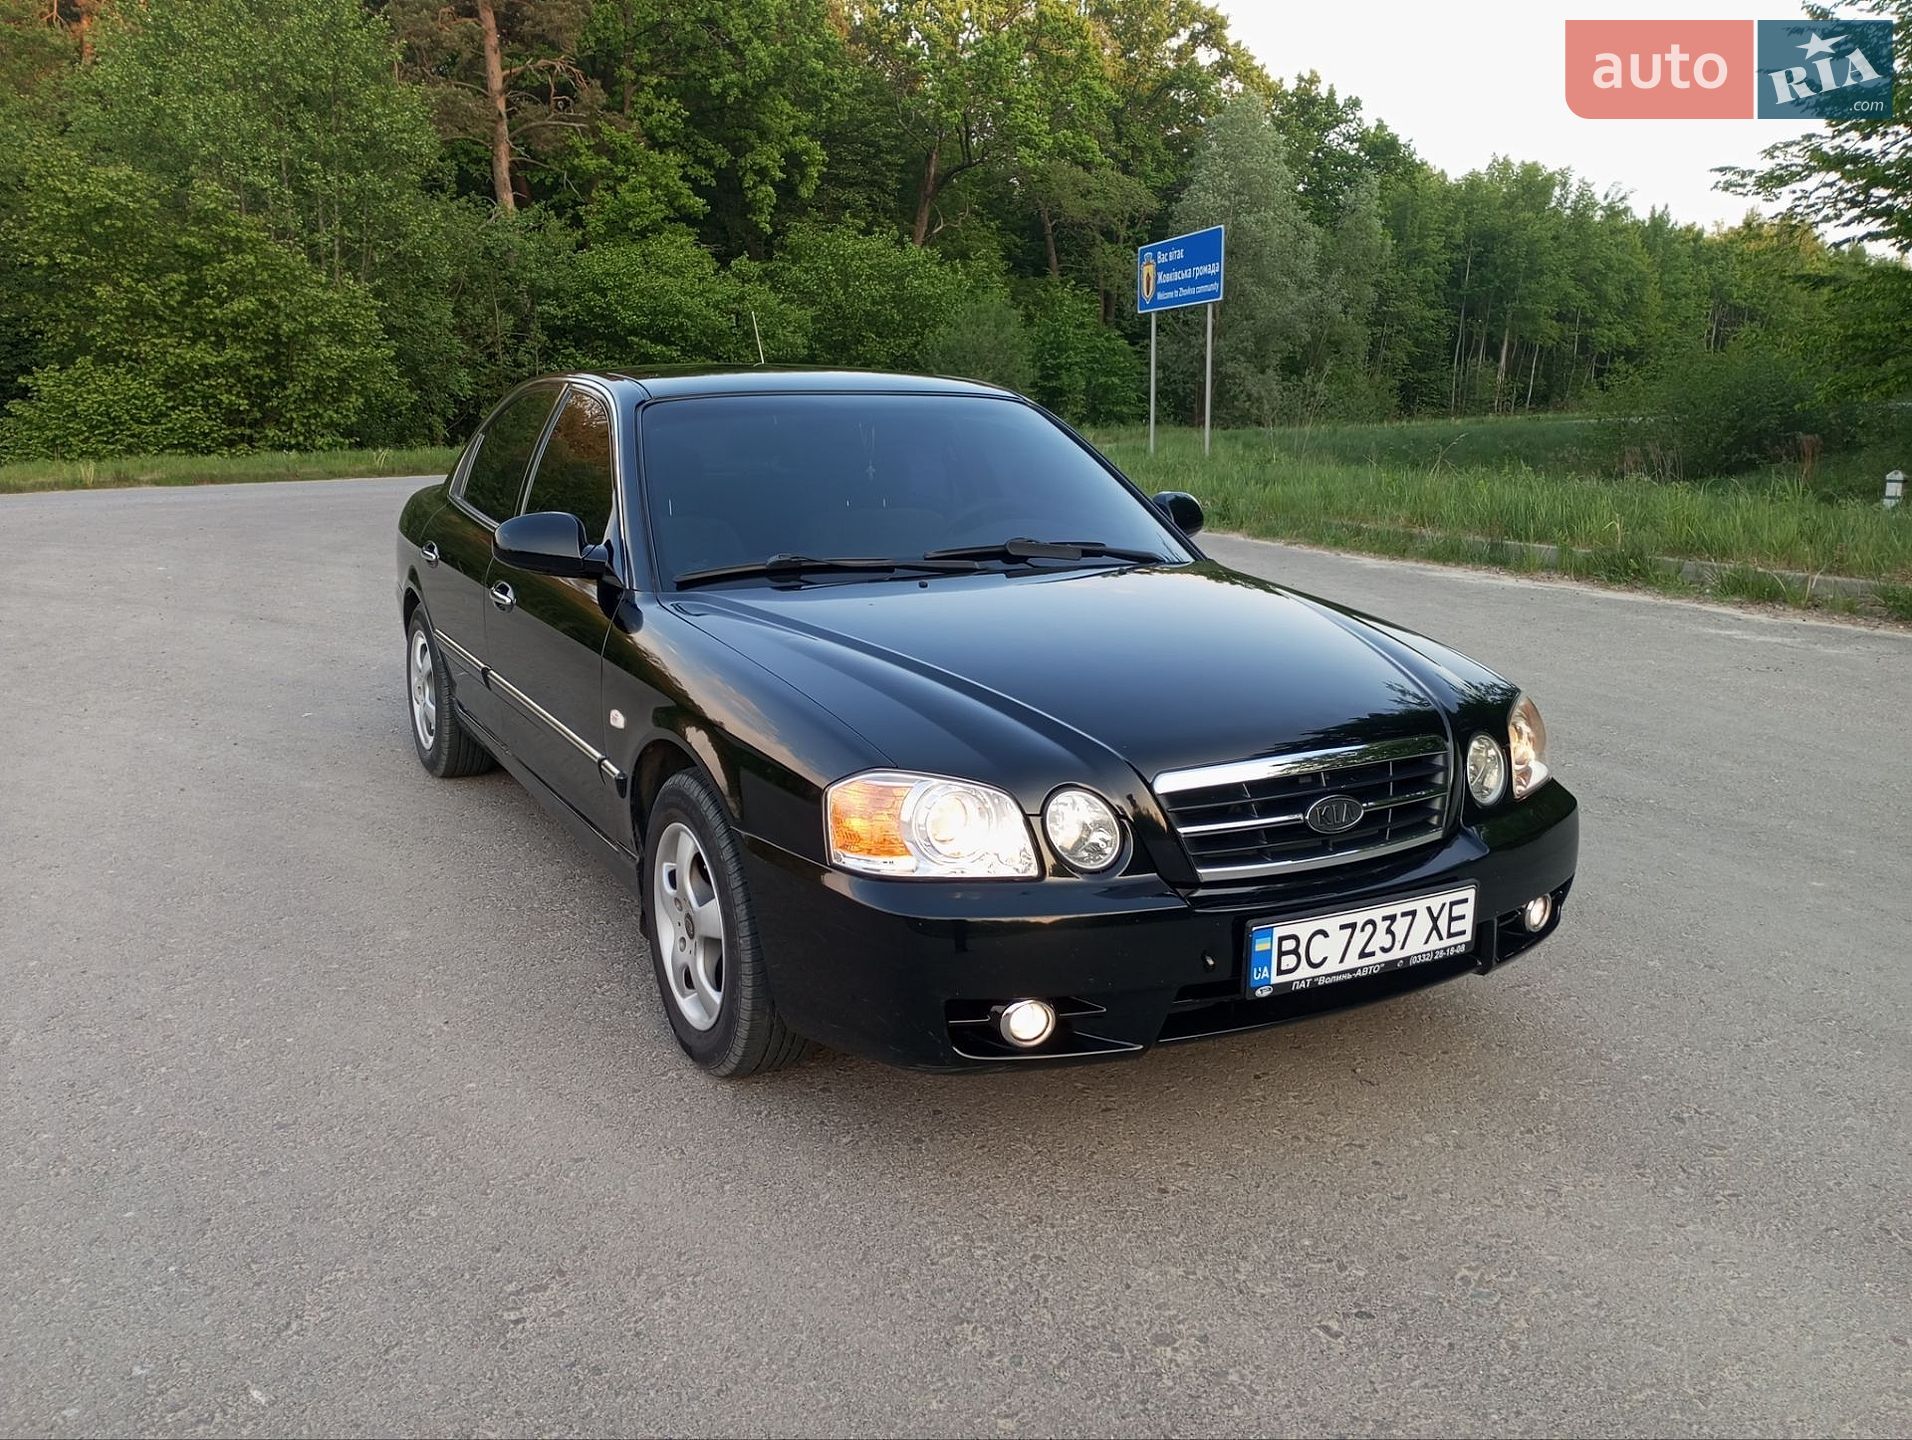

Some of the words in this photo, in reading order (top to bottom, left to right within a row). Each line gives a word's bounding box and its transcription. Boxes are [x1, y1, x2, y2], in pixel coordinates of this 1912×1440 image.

[1157, 251, 1168, 264] Вас
[1169, 247, 1184, 261] вітає
[1157, 268, 1191, 284] Жовківська
[1192, 262, 1220, 280] громада
[1276, 929, 1330, 976] BC
[1338, 909, 1418, 964] 7237
[1423, 897, 1469, 945] XE
[1253, 966, 1270, 980] UA
[1292, 979, 1312, 991] ПАТ
